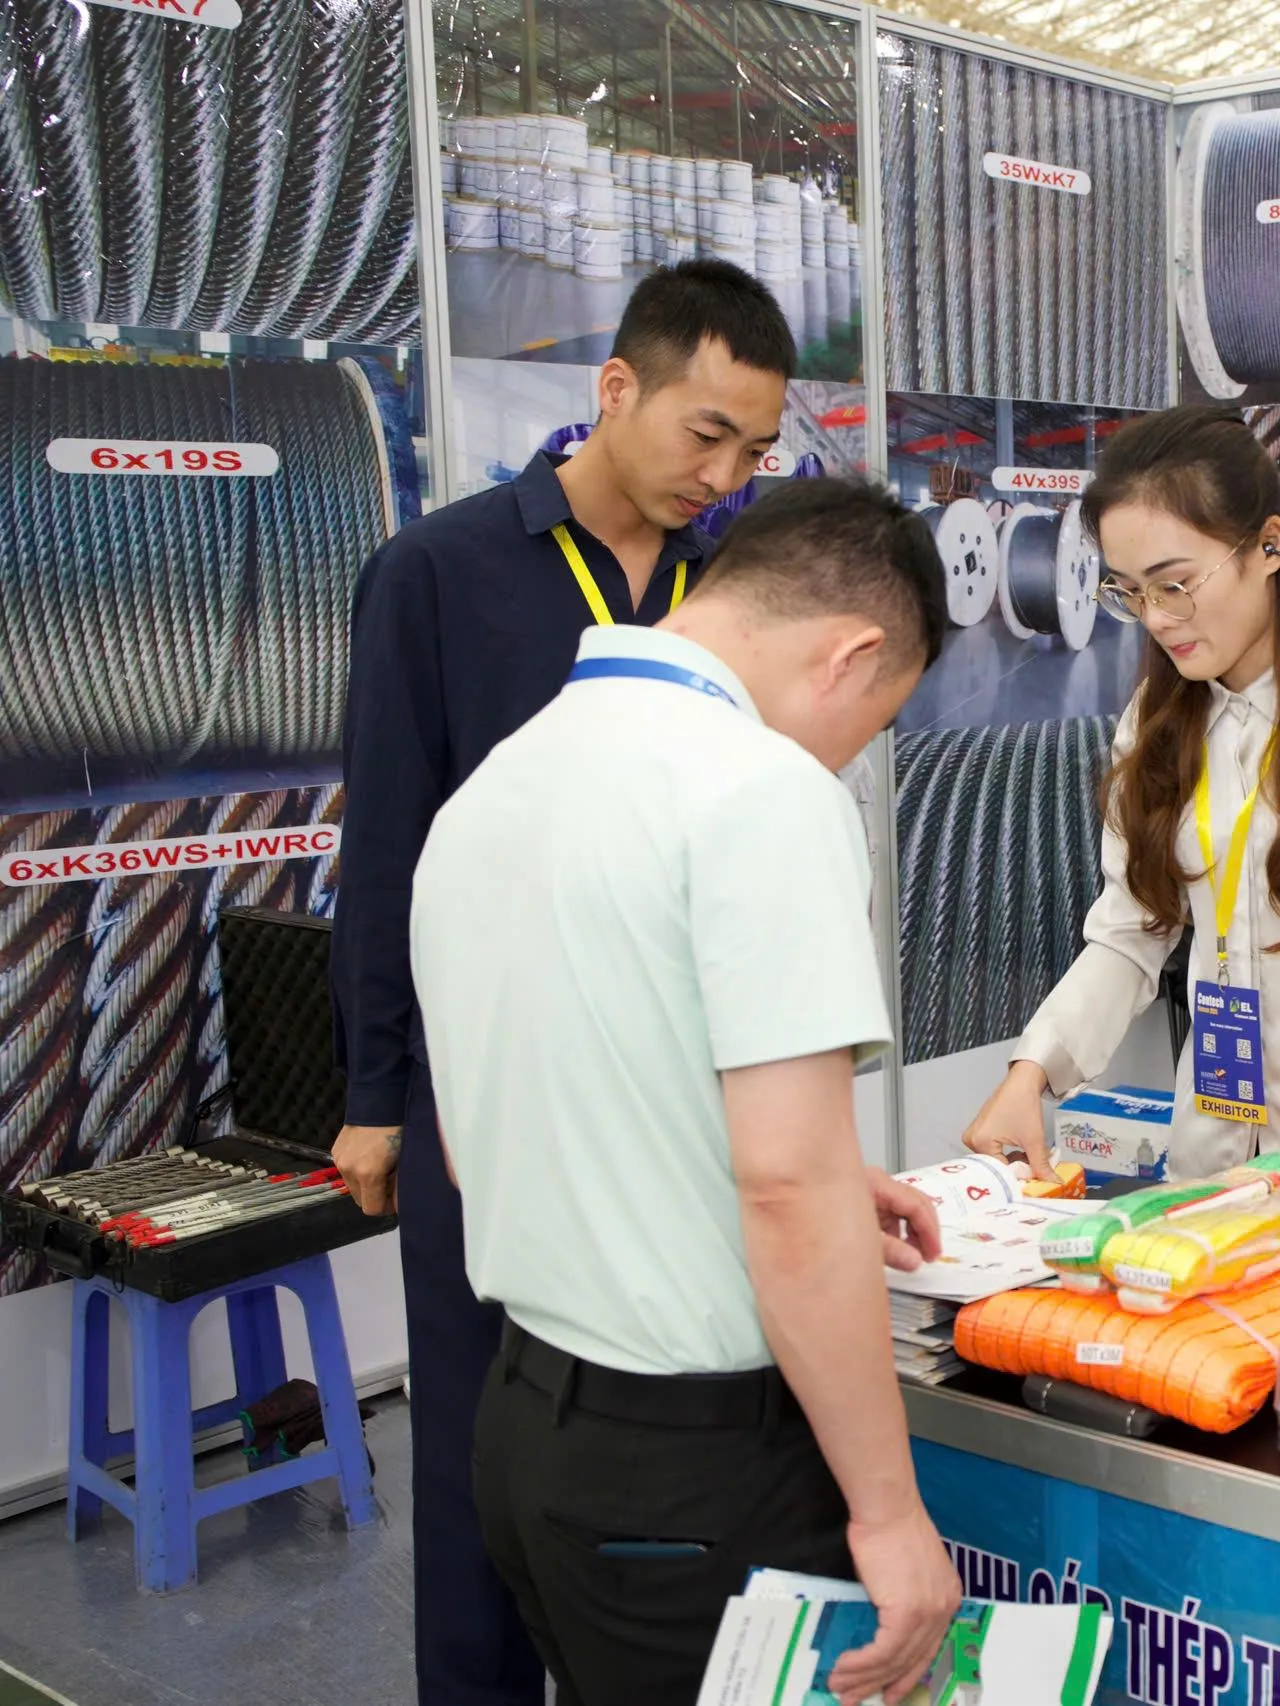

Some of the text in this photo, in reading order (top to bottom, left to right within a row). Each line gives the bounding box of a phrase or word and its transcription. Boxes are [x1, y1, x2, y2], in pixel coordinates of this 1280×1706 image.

[1000, 160, 1076, 189] 35WxK7
[90, 447, 243, 472] 6x19S
[1011, 473, 1081, 490] 4Vx39S
[9, 830, 335, 881] 6xK36WS+IWRC
[1201, 1099, 1259, 1120] EXHIBITOR
[1122, 1596, 1234, 1706] THÉP
